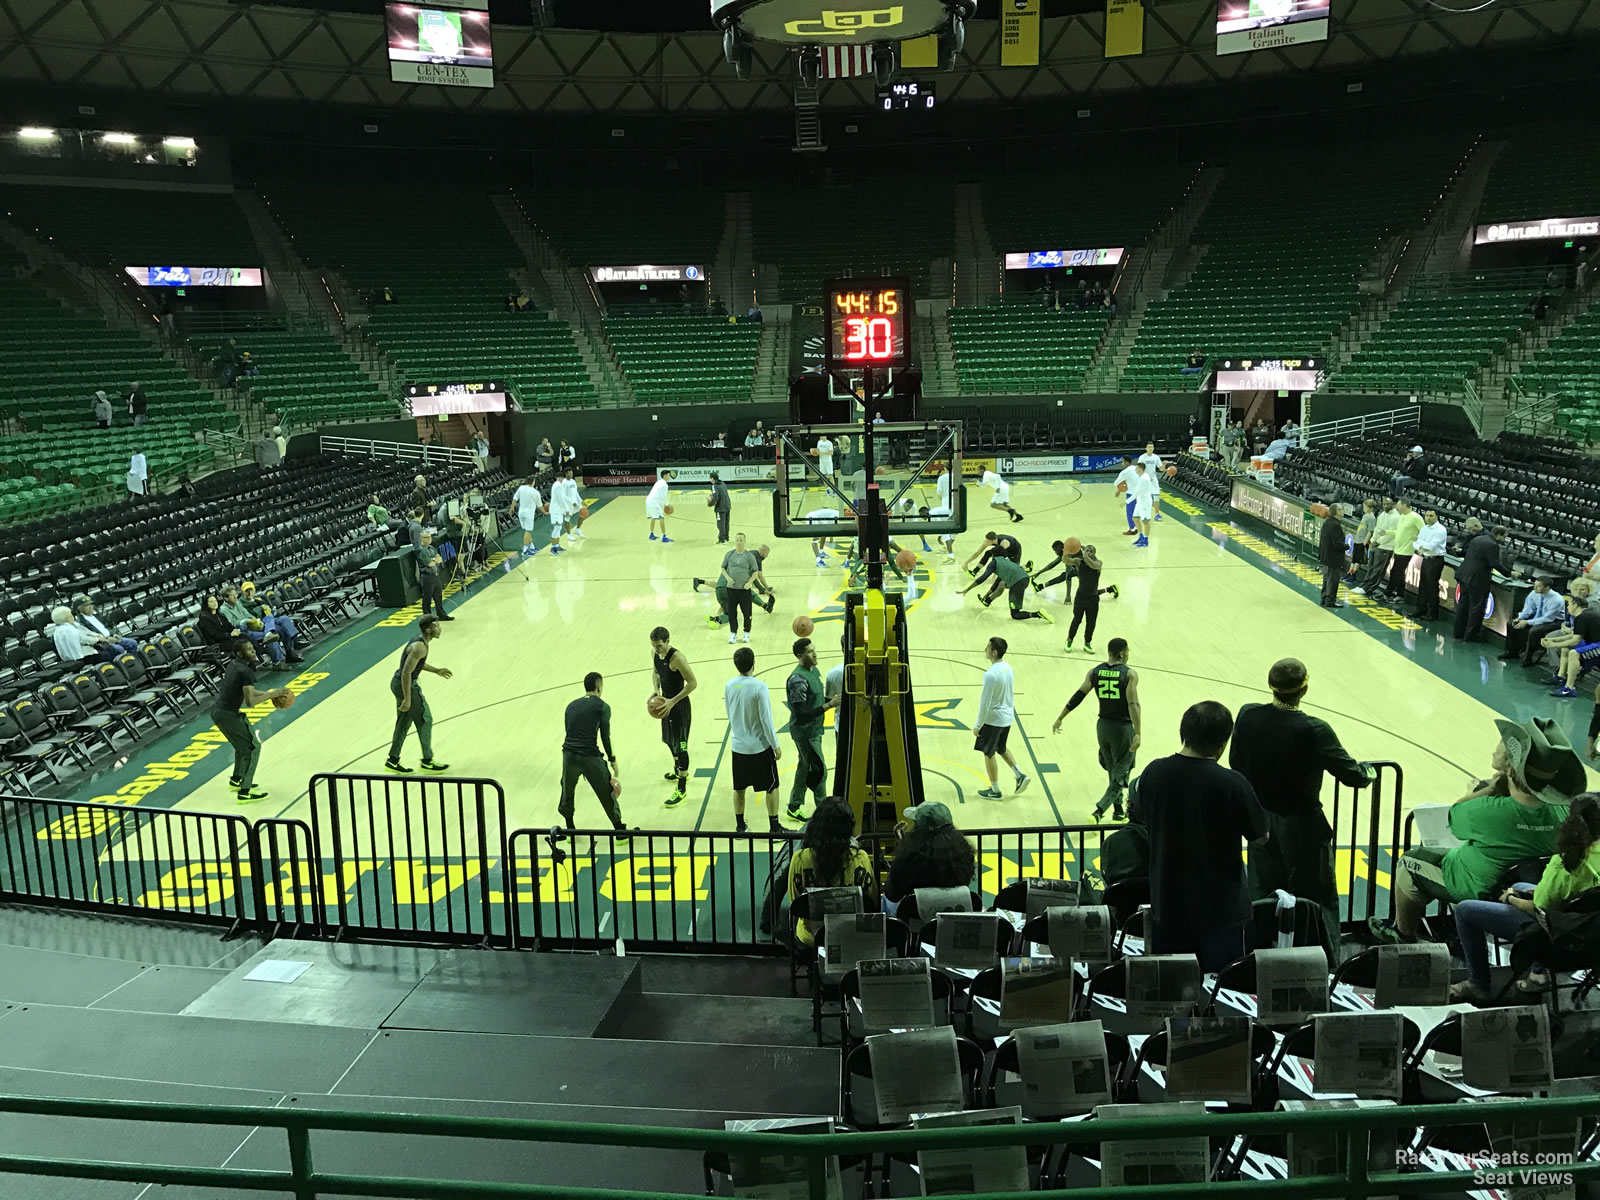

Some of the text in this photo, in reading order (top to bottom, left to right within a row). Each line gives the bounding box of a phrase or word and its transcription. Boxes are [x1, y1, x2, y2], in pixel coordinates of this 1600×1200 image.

[1248, 28, 1284, 40] Italian
[1252, 36, 1296, 48] Granite
[416, 64, 467, 78] CEN-TEX
[417, 75, 470, 84] ROOF SYSTEMS
[884, 97, 892, 110] 0
[926, 95, 934, 108] 0
[836, 291, 898, 315] 44:15
[846, 318, 892, 359] 30
[1260, 360, 1281, 368] 44:15
[446, 384, 465, 392] 44:15
[427, 402, 484, 415] BASKETBALL
[609, 468, 630, 476] Waco
[592, 475, 647, 485] Tribune Herald
[1238, 487, 1263, 517] Welcome
[1263, 501, 1271, 520] to
[1282, 504, 1304, 535] Ferrell
[1097, 679, 1121, 699] 25
